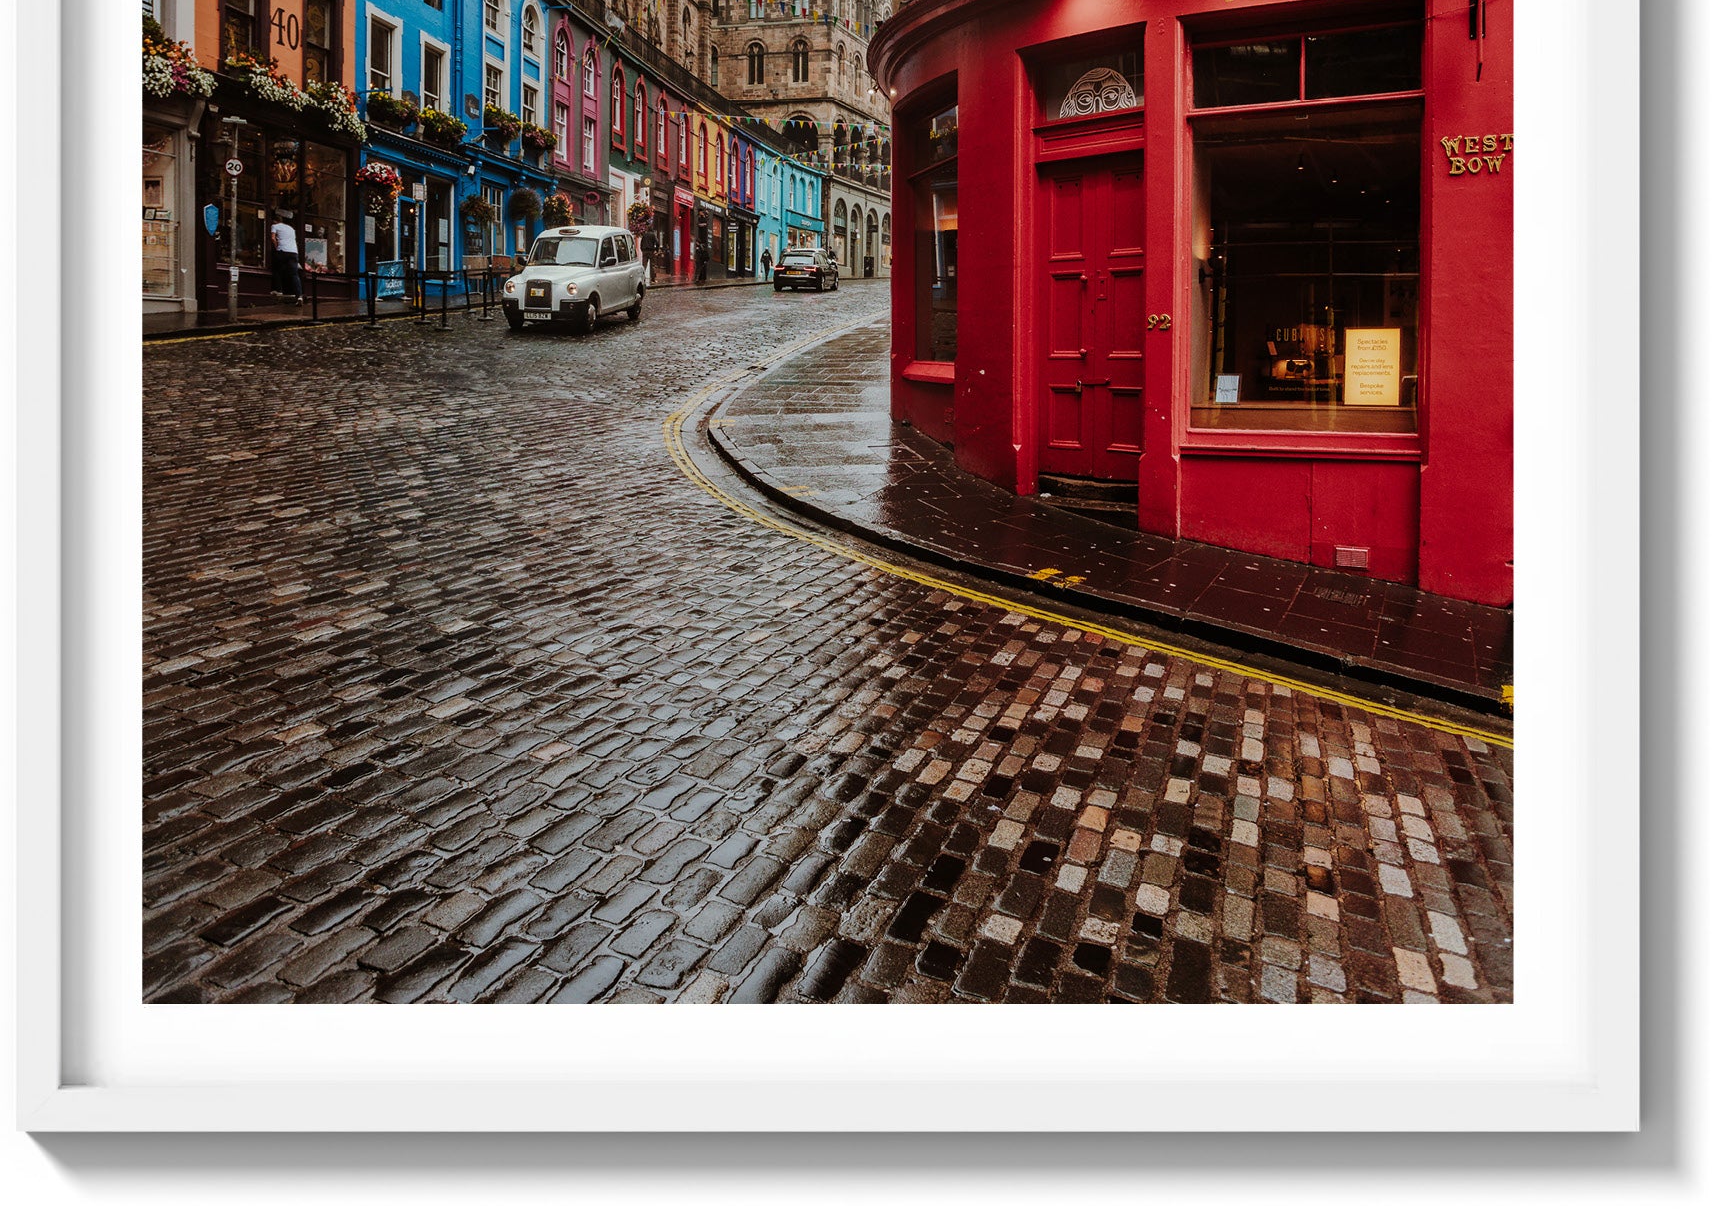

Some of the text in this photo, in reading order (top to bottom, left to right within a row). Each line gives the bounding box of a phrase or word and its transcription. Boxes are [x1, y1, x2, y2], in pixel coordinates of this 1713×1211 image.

[271, 7, 299, 50] 40
[1440, 134, 1514, 157] WEST
[227, 162, 242, 172] 20
[1449, 153, 1506, 175] BOW
[1147, 314, 1171, 329] 92
